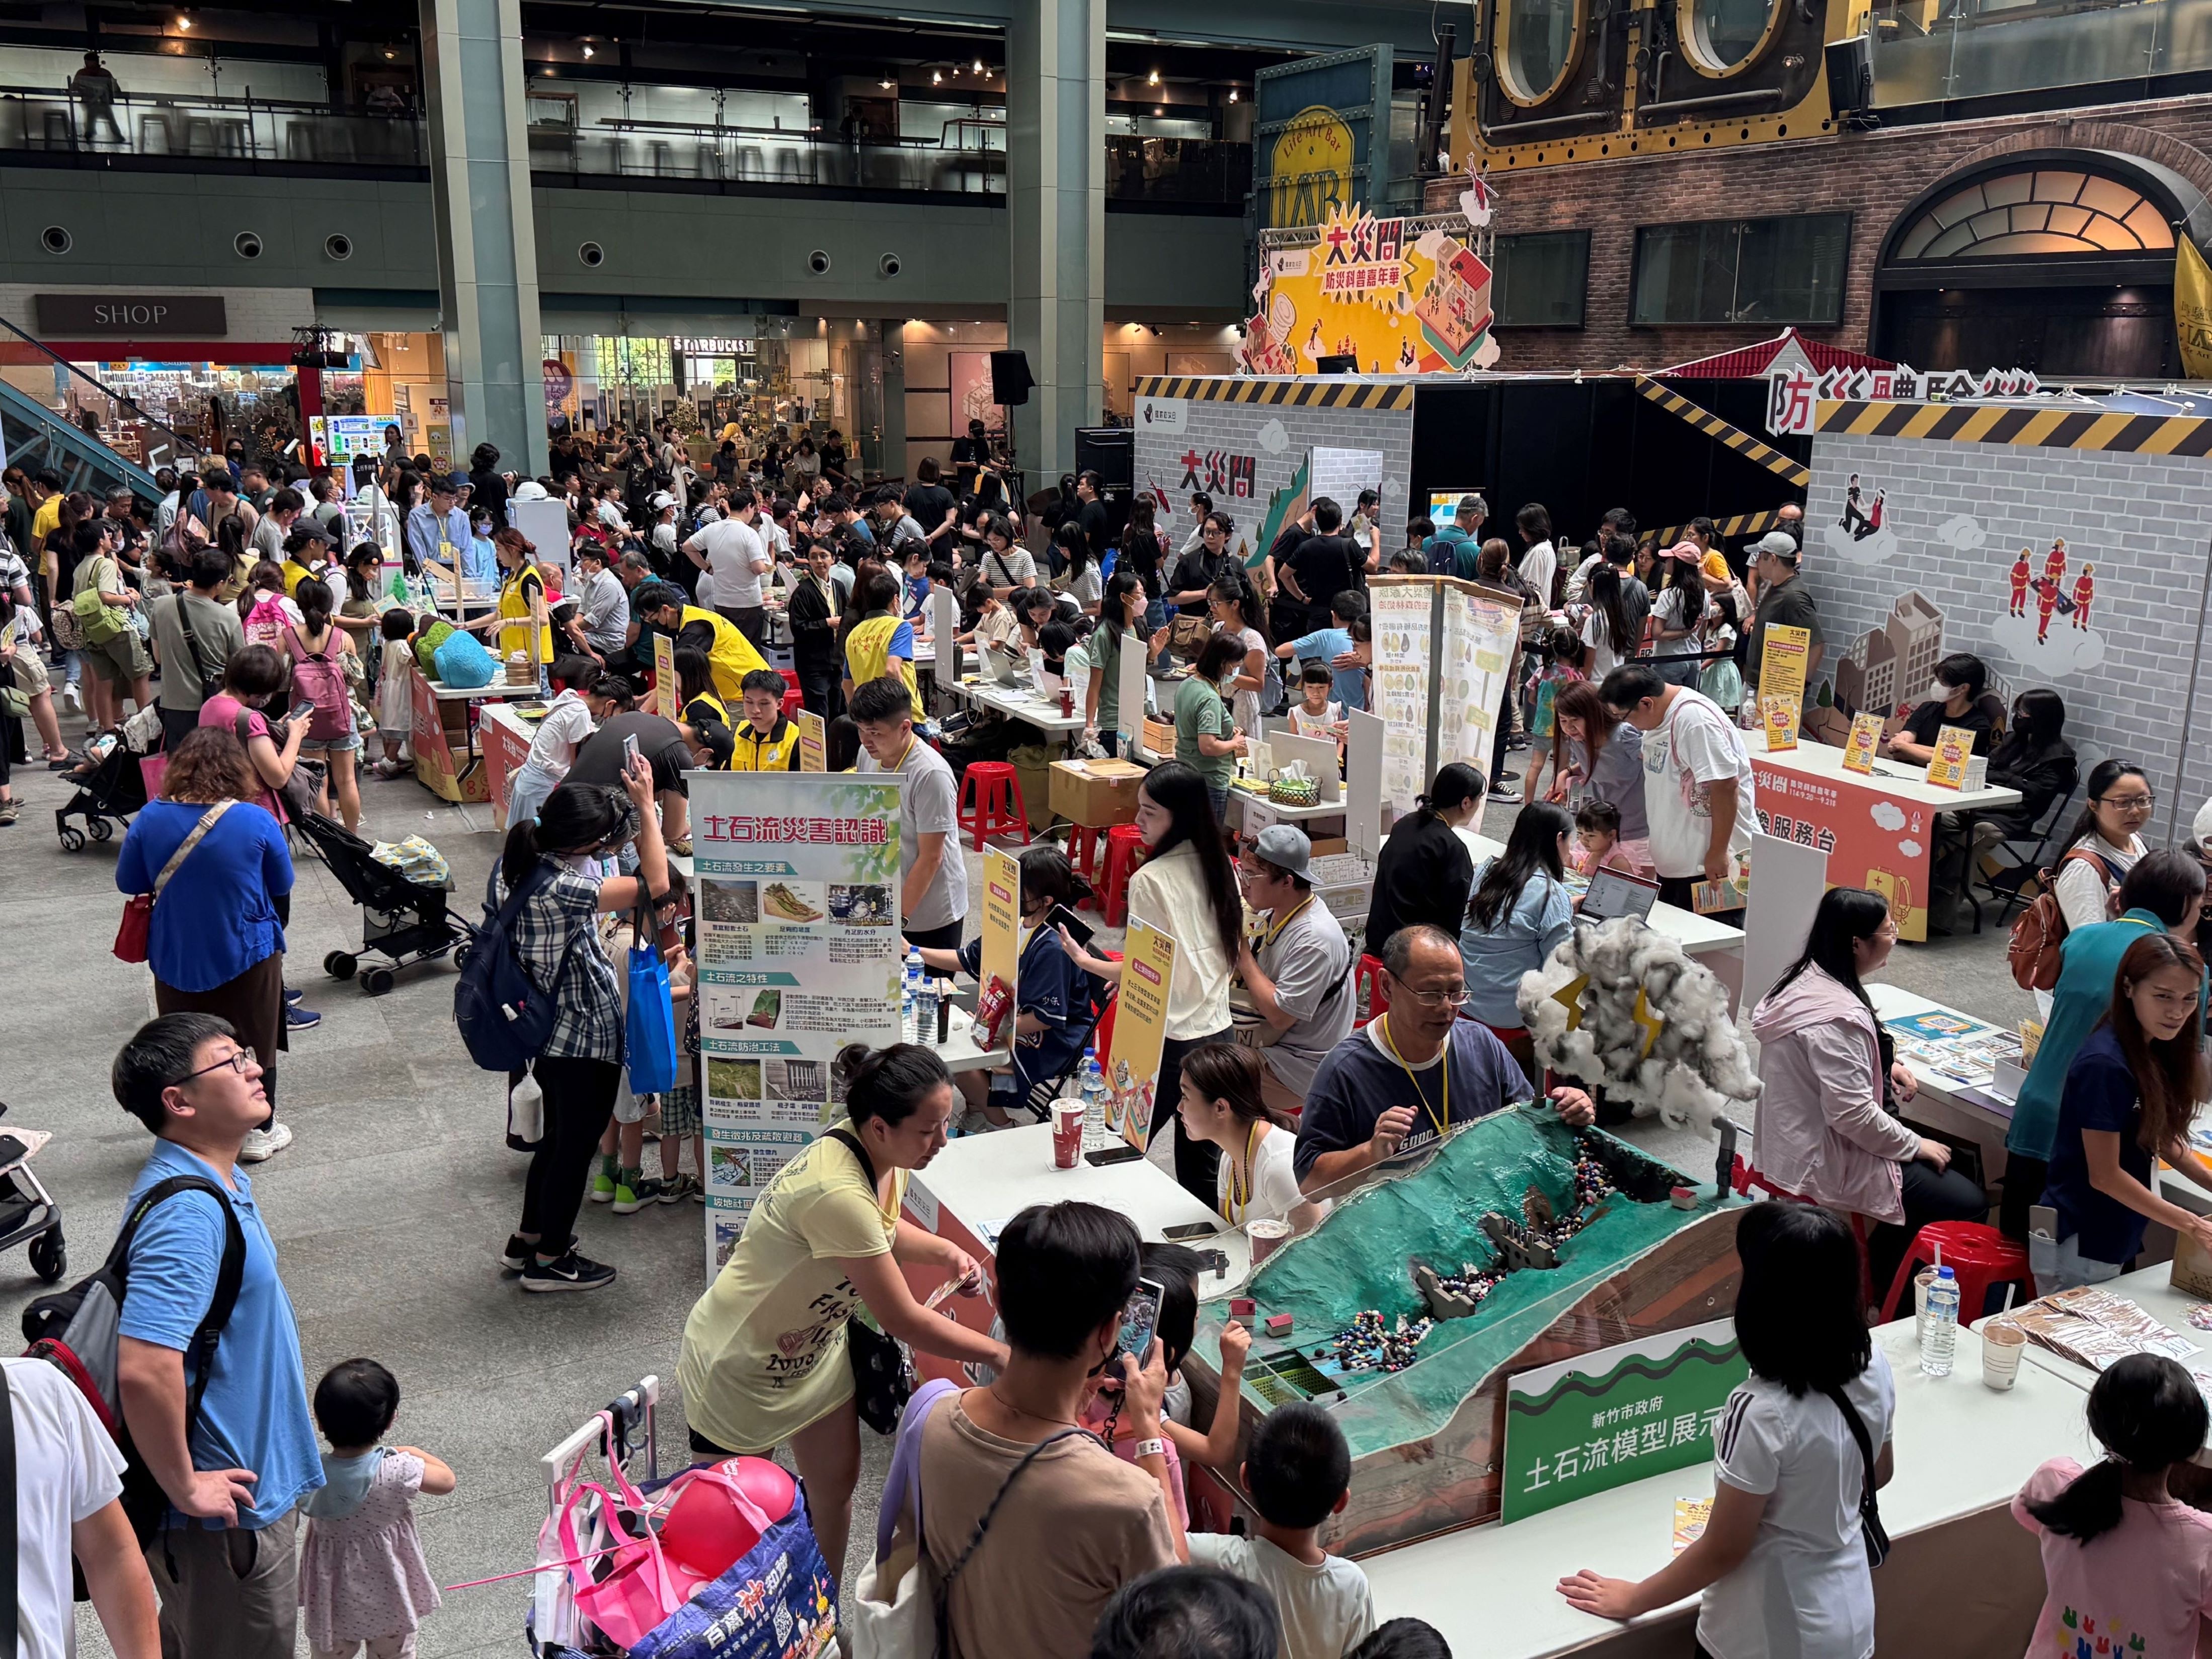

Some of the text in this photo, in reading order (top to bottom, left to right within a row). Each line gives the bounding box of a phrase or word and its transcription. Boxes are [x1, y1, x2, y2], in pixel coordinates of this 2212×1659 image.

[1284, 124, 1341, 159] Life Art Bar
[1326, 219, 1403, 266] 大災問
[1325, 266, 1400, 290] 防災科普嘉年華
[95, 304, 168, 325] SHOP
[674, 339, 744, 352] STARBUCKS
[1179, 449, 1256, 499] 大災問
[702, 815, 888, 844] 土石流災害認識
[702, 860, 786, 874] 土石流發生之要素
[706, 972, 768, 984] 土石流之特性
[708, 1041, 781, 1053] 土石流防治工法
[766, 1354, 815, 1371] 2000
[1592, 1395, 1664, 1429] 新竹市政府
[1523, 1406, 1726, 1493] 土石流模型展示
